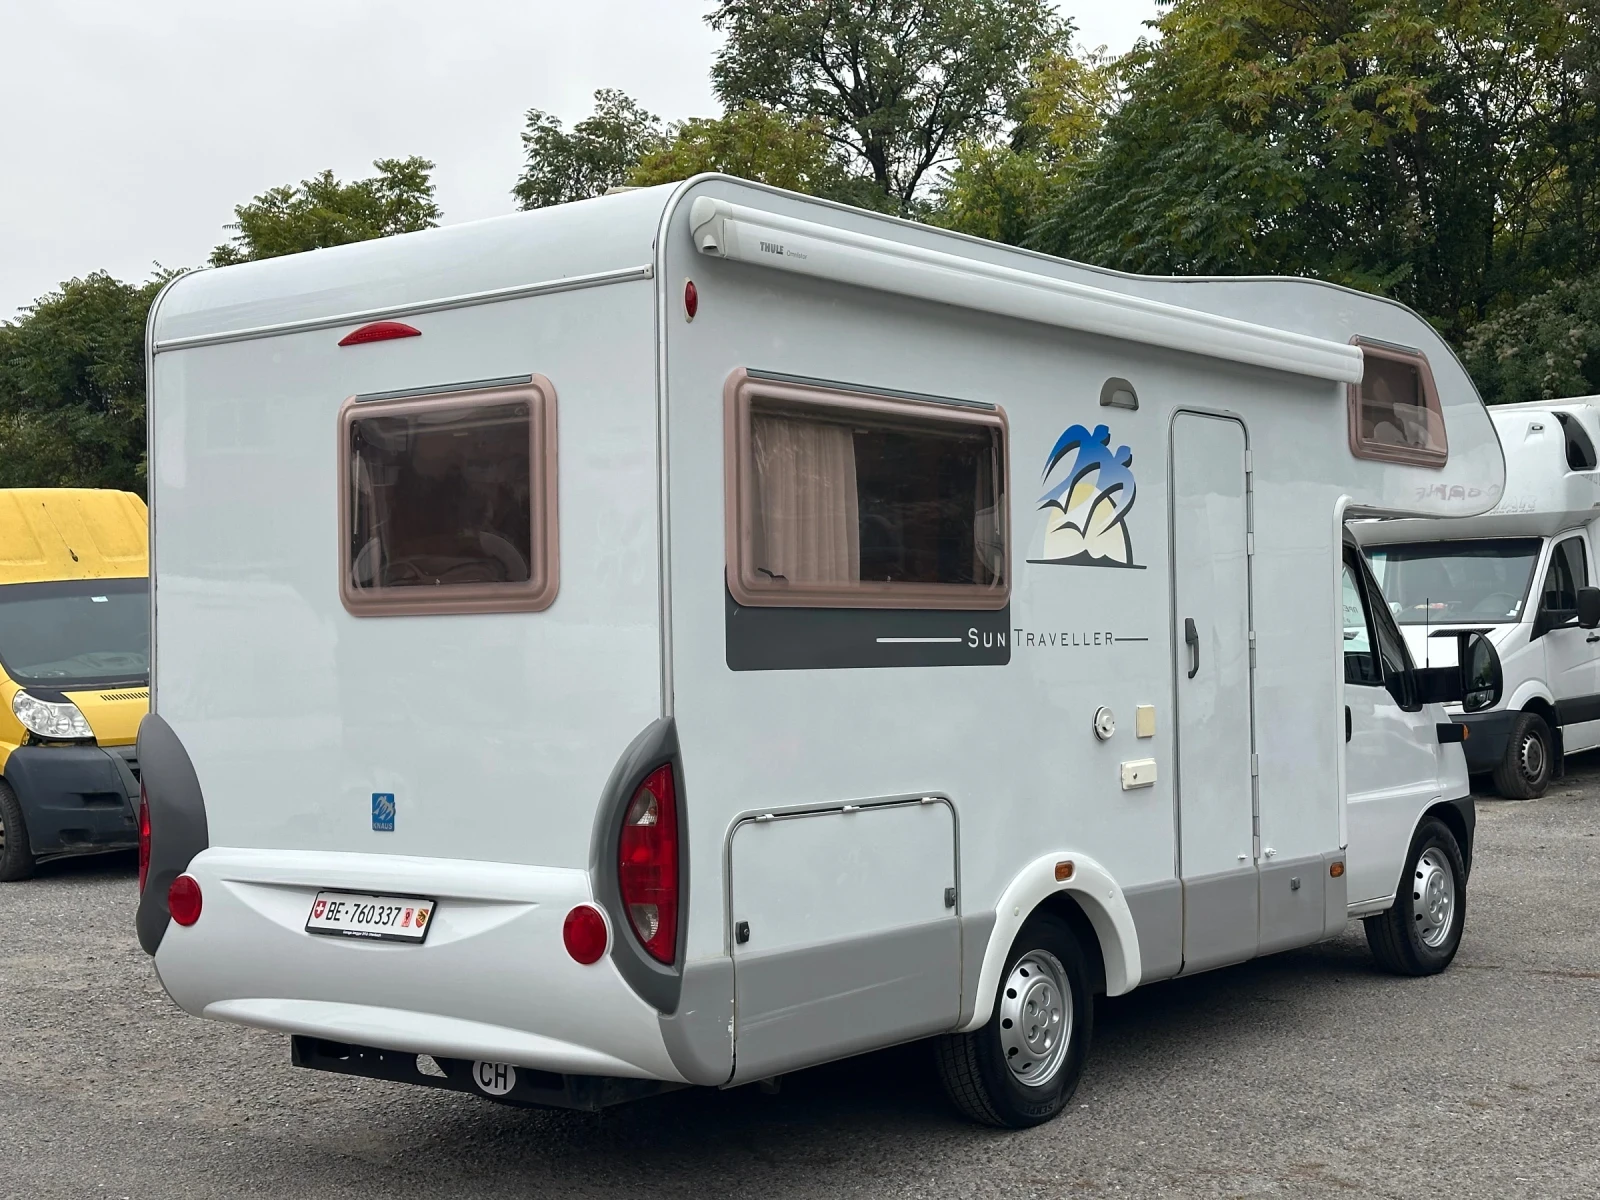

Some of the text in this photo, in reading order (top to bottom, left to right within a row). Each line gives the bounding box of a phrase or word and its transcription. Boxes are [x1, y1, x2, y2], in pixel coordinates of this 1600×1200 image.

[760, 241, 784, 255] THULE
[373, 822, 393, 830] KNAUS
[479, 1061, 508, 1091] CH
